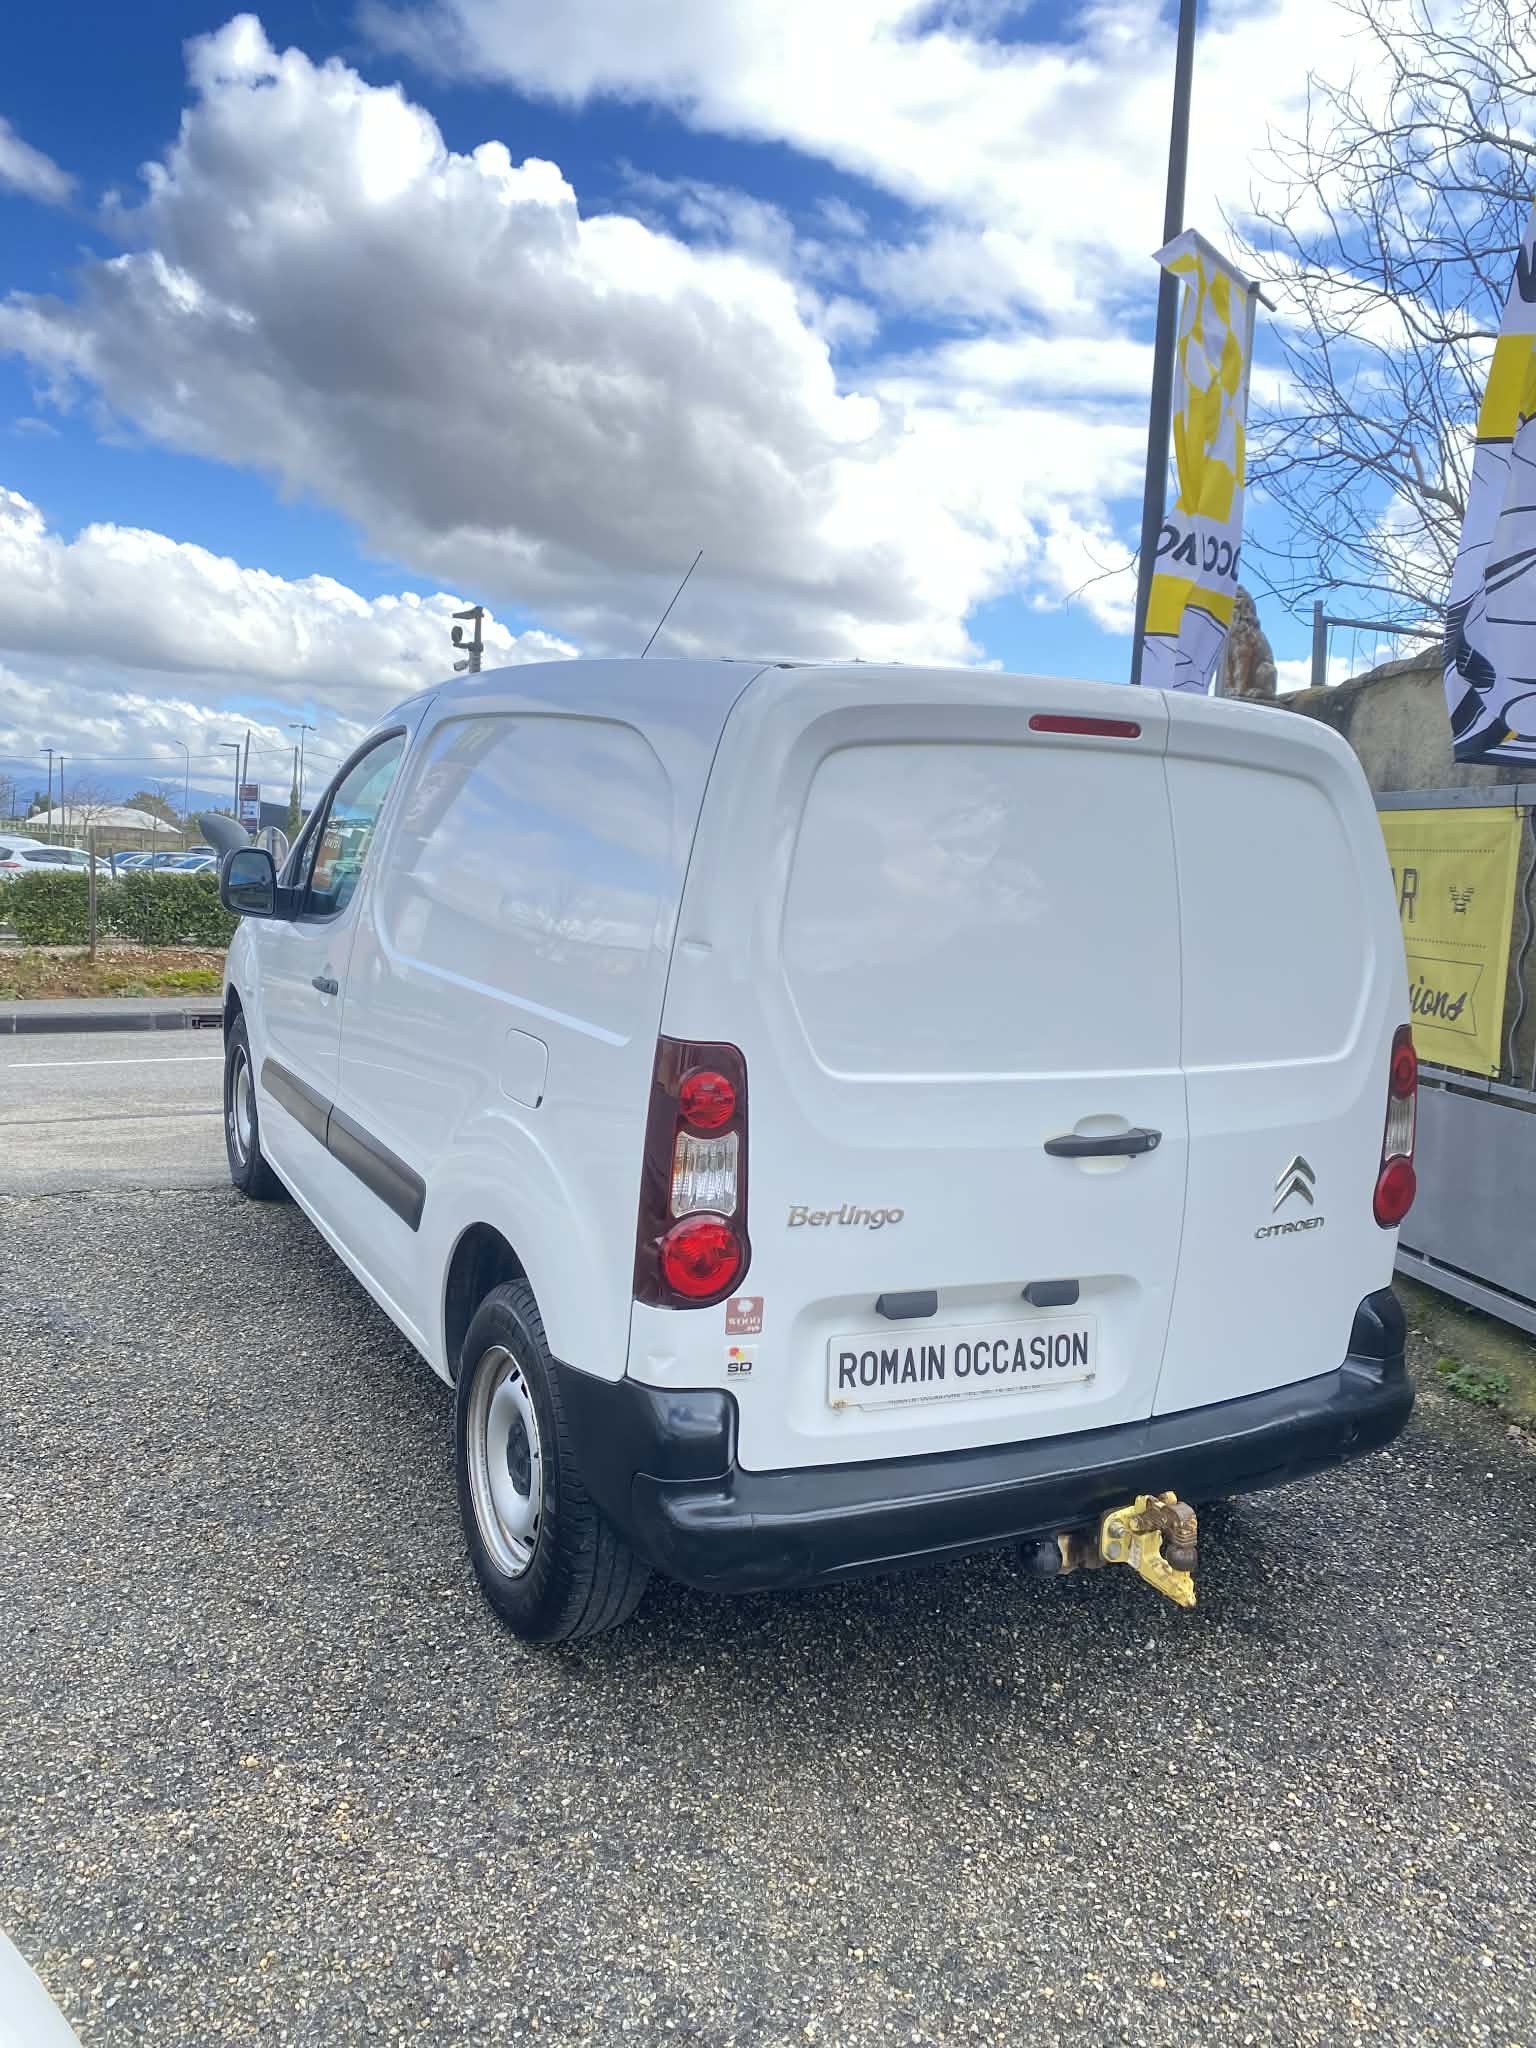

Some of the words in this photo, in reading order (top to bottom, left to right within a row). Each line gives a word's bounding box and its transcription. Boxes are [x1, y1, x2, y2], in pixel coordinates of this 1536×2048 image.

[787, 1203, 905, 1230] Berlingo
[727, 1362, 753, 1373] SD
[838, 1344, 946, 1389] ROMAIN
[954, 1331, 1089, 1378] OCCASION
